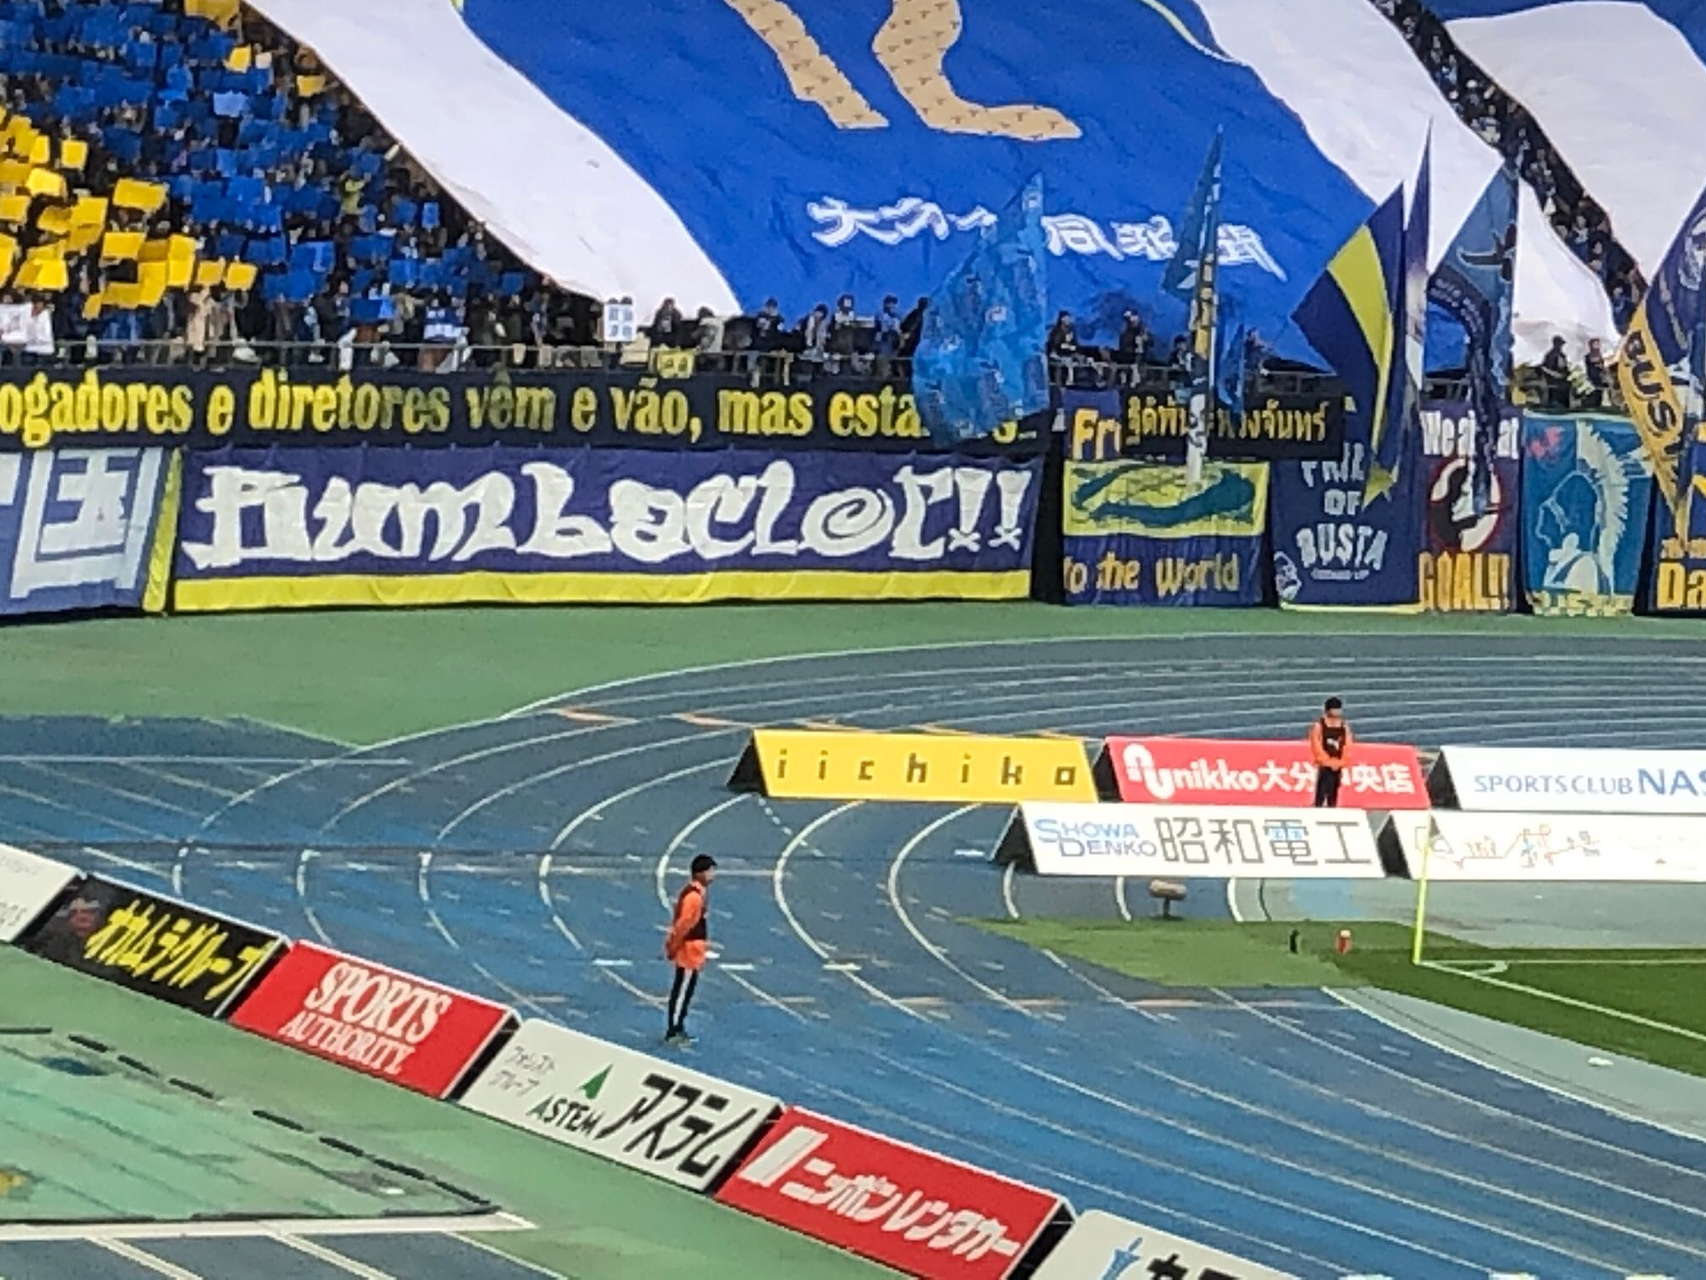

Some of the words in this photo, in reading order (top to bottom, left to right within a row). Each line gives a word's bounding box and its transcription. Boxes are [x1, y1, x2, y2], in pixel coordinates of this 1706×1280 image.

[207, 383, 235, 435] e
[248, 367, 452, 435] diretores
[571, 383, 598, 431] e
[718, 386, 814, 437] mas
[1323, 488, 1362, 516] OF
[1155, 552, 1240, 598] World
[774, 747, 1078, 787] iichiko
[1474, 774, 1569, 794] SPORTS
[1570, 775, 1634, 795] CLUB
[1034, 818, 1140, 843] SHOWA
[1058, 836, 1158, 858] DENKO
[1153, 816, 1373, 866] 昭和電工
[306, 960, 453, 1044] SPORTS
[278, 1009, 417, 1076] AUTHORITY
[525, 1093, 605, 1142] ASTEM
[597, 1071, 763, 1177] アステム
[779, 1158, 1022, 1262] ニッポンレンタカー
